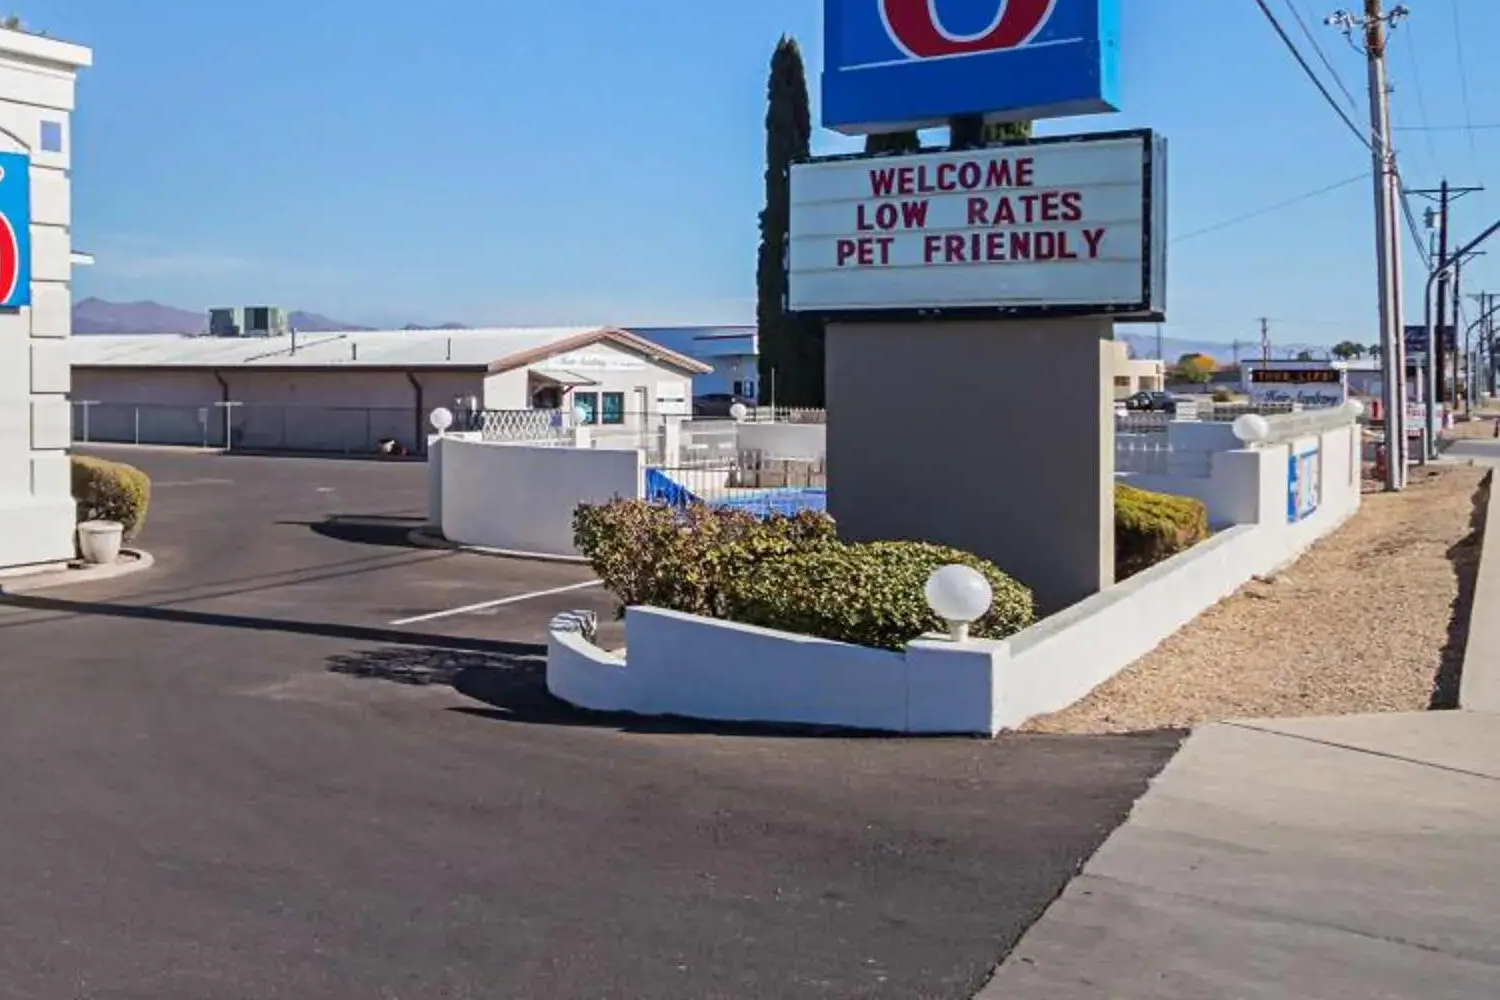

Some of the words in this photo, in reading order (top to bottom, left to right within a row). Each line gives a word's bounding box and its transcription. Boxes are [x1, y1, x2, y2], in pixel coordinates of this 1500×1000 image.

[869, 157, 1034, 197] WELCOME
[857, 200, 928, 231] LOW
[967, 191, 1082, 225] RATES
[837, 237, 894, 267] PET
[924, 228, 1105, 262] FRIENDLY
